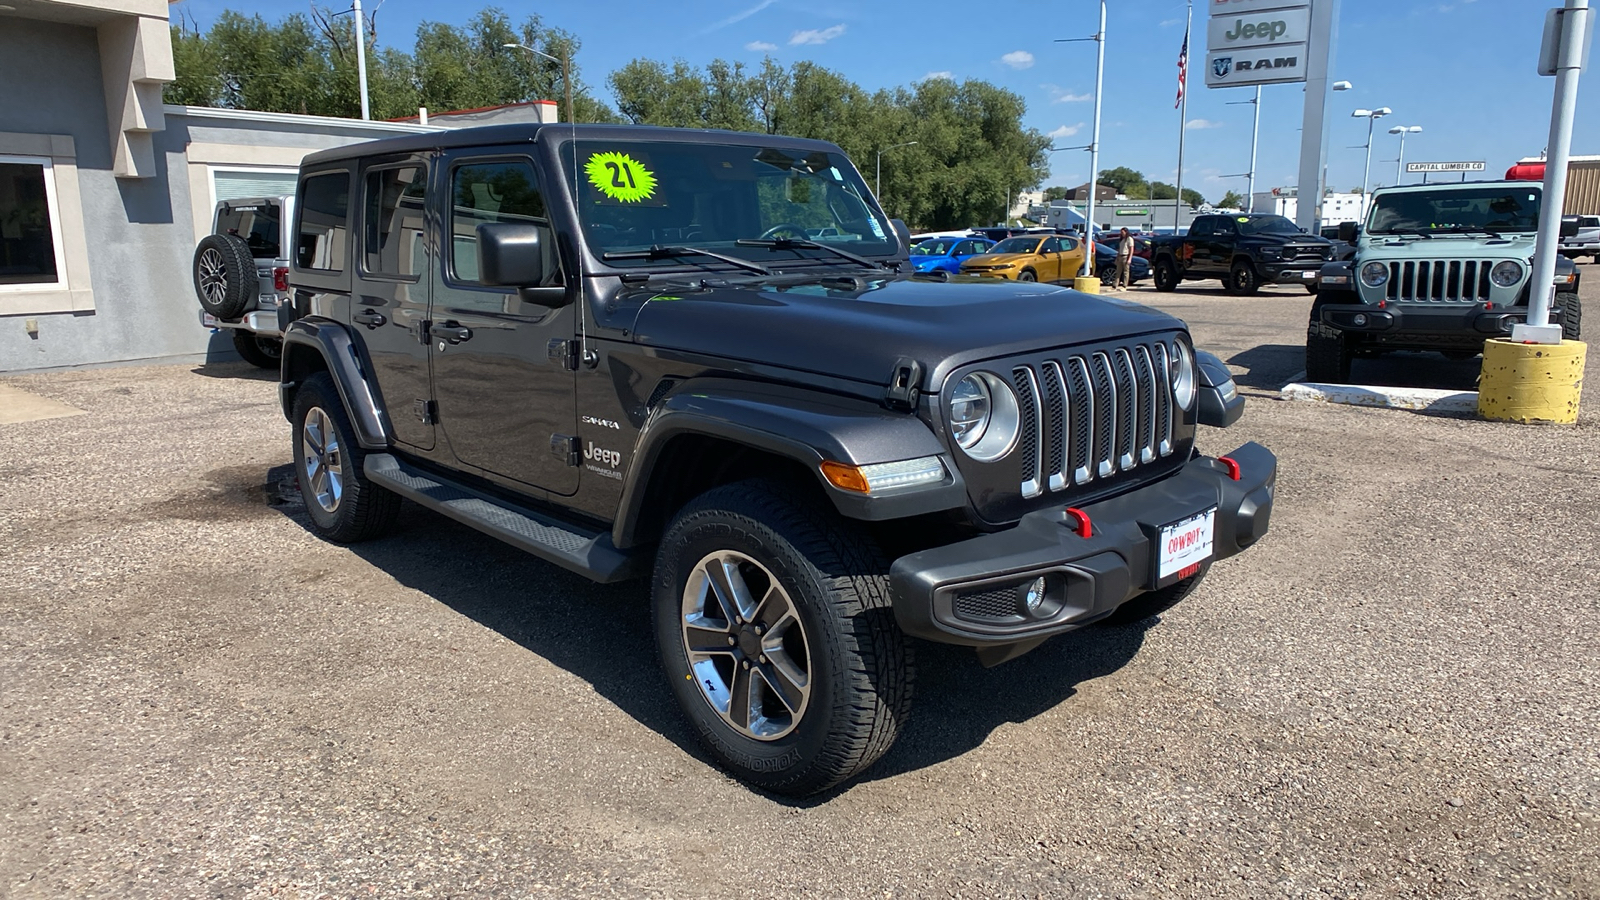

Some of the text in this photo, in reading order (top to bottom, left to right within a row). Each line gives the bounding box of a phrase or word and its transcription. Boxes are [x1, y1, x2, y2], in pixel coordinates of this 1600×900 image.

[1225, 19, 1287, 41] Jeep
[1235, 57, 1297, 71] RAM
[604, 161, 637, 188] 21
[582, 415, 620, 430] SAHARA
[583, 441, 621, 468] Jeep
[586, 464, 621, 477] WRANGLER
[1168, 527, 1200, 554] COWBOY
